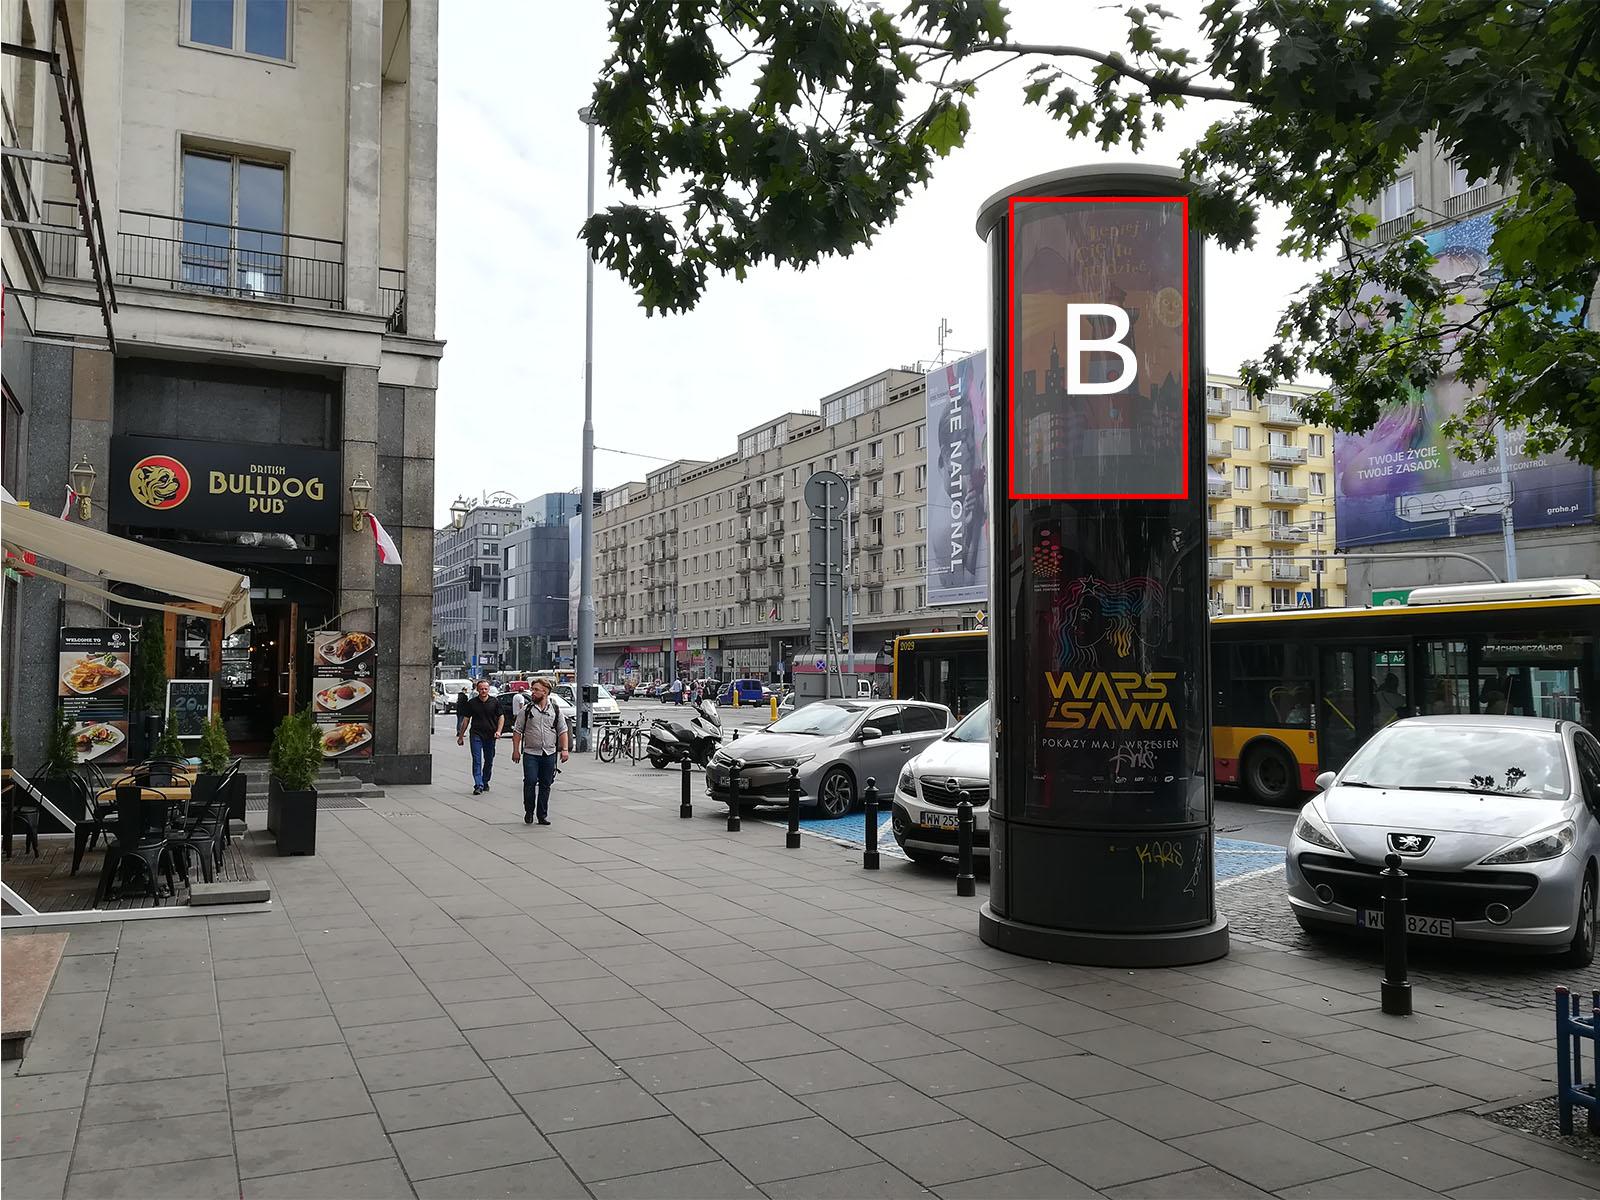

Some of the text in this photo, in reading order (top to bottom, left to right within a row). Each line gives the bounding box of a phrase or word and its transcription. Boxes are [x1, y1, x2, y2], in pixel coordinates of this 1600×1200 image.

[1368, 446, 1441, 466] TWOJE ŻYCIE.
[250, 464, 286, 475] BRITISH
[950, 378, 963, 574] THE NATIONAL
[1358, 458, 1441, 480] TWOJE ZASADY.
[1463, 469, 1487, 478] GROHE
[209, 471, 324, 500] BULLDOG
[249, 497, 285, 514] PUB
[492, 497, 512, 505] PGE
[1547, 504, 1579, 515] grohe.pl
[1045, 672, 1177, 699] WARS
[1042, 738, 1087, 749] POKAZY
[1091, 739, 1116, 750] MAJ
[1125, 737, 1179, 749] WRZESIEŃ
[926, 814, 960, 827] WW 255
[1408, 917, 1450, 937] 826E
